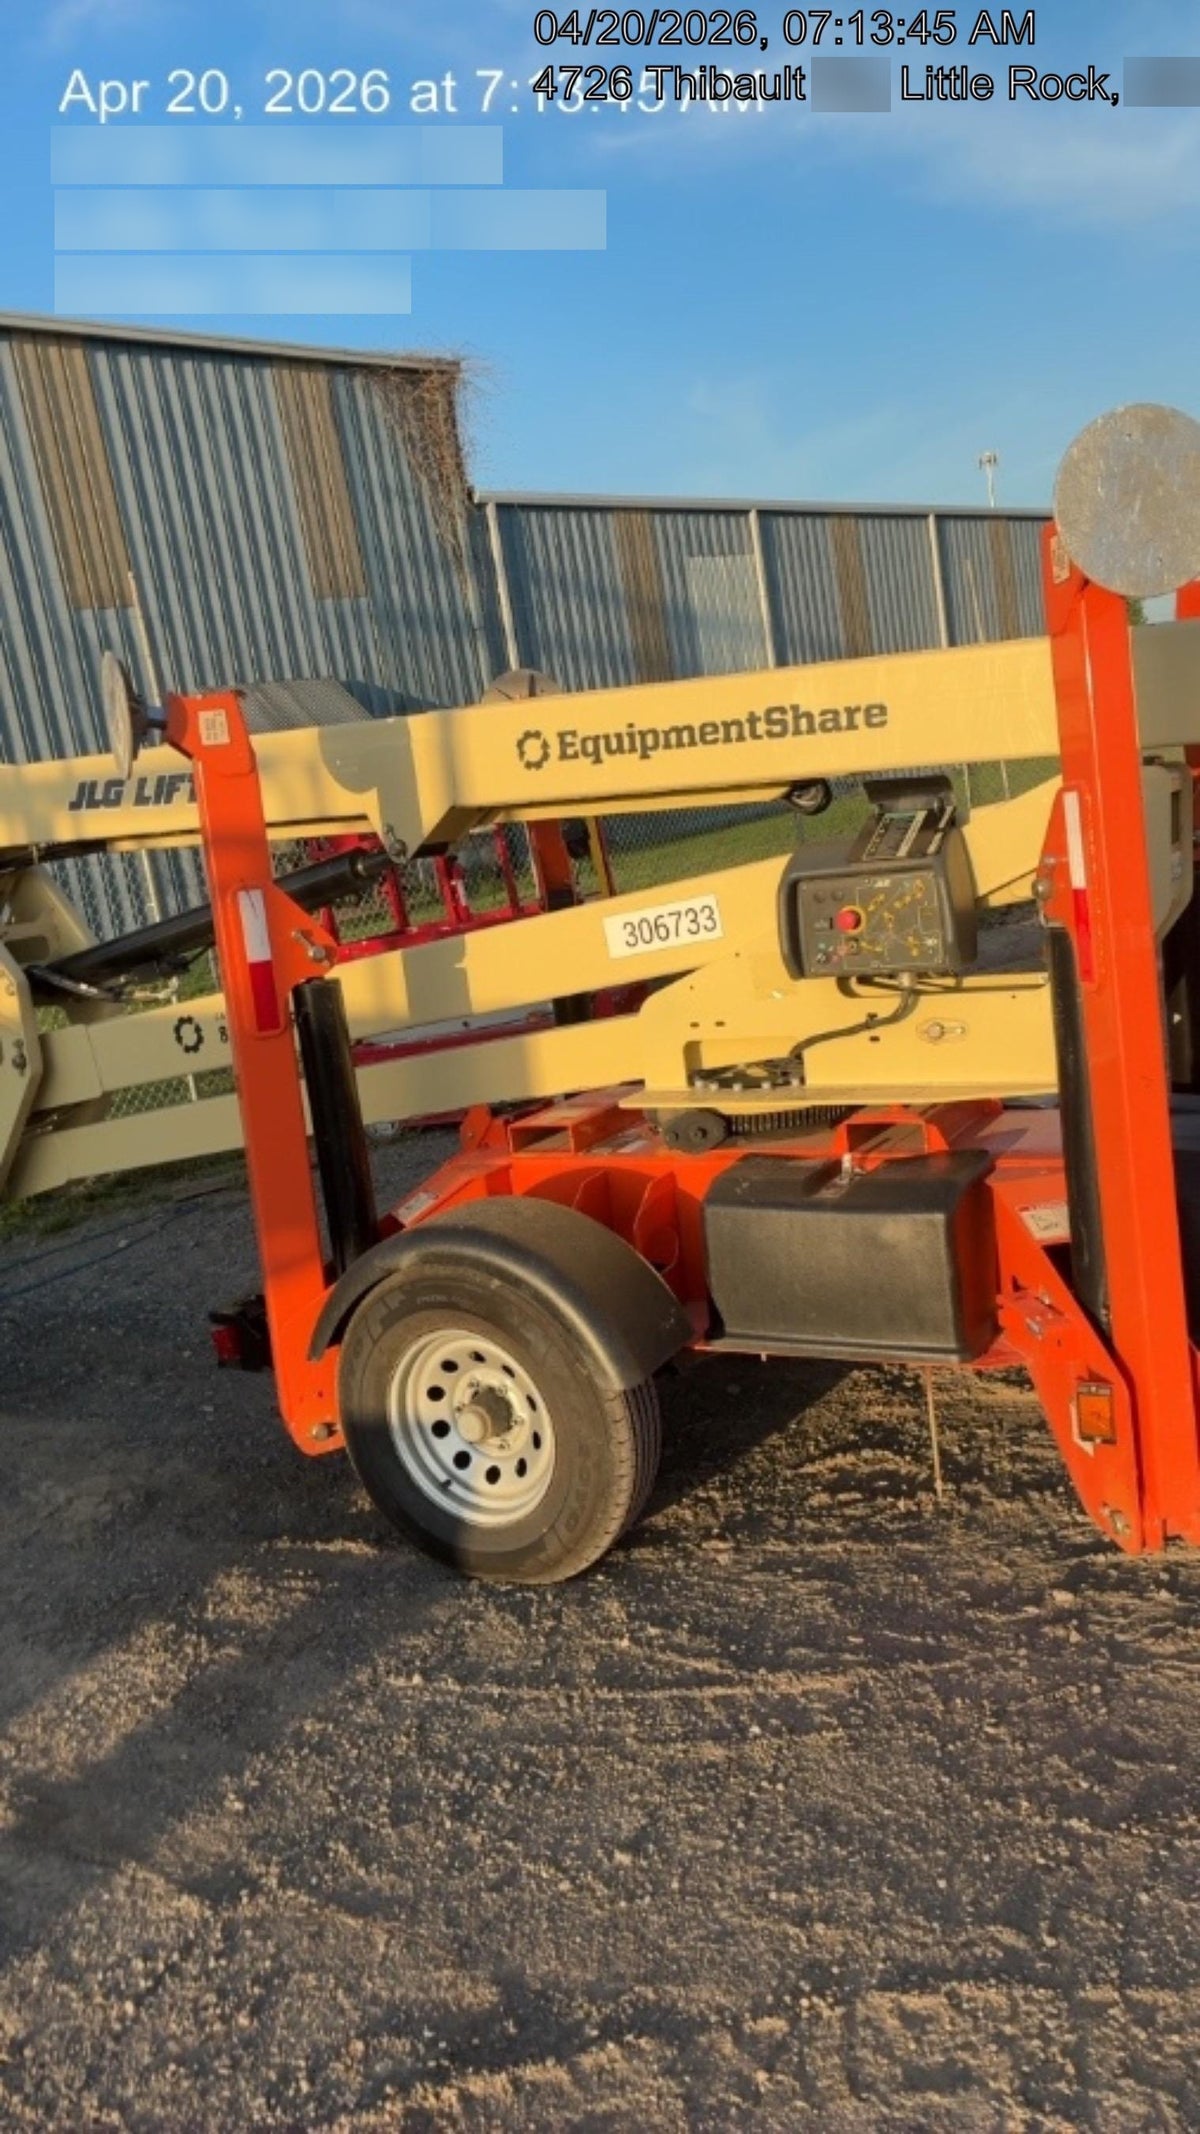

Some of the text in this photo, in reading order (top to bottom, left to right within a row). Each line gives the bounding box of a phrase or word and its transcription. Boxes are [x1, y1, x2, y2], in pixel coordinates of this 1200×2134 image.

[557, 702, 889, 766] EquipmentShare
[68, 779, 124, 812] JLG
[623, 904, 717, 948] 306733
